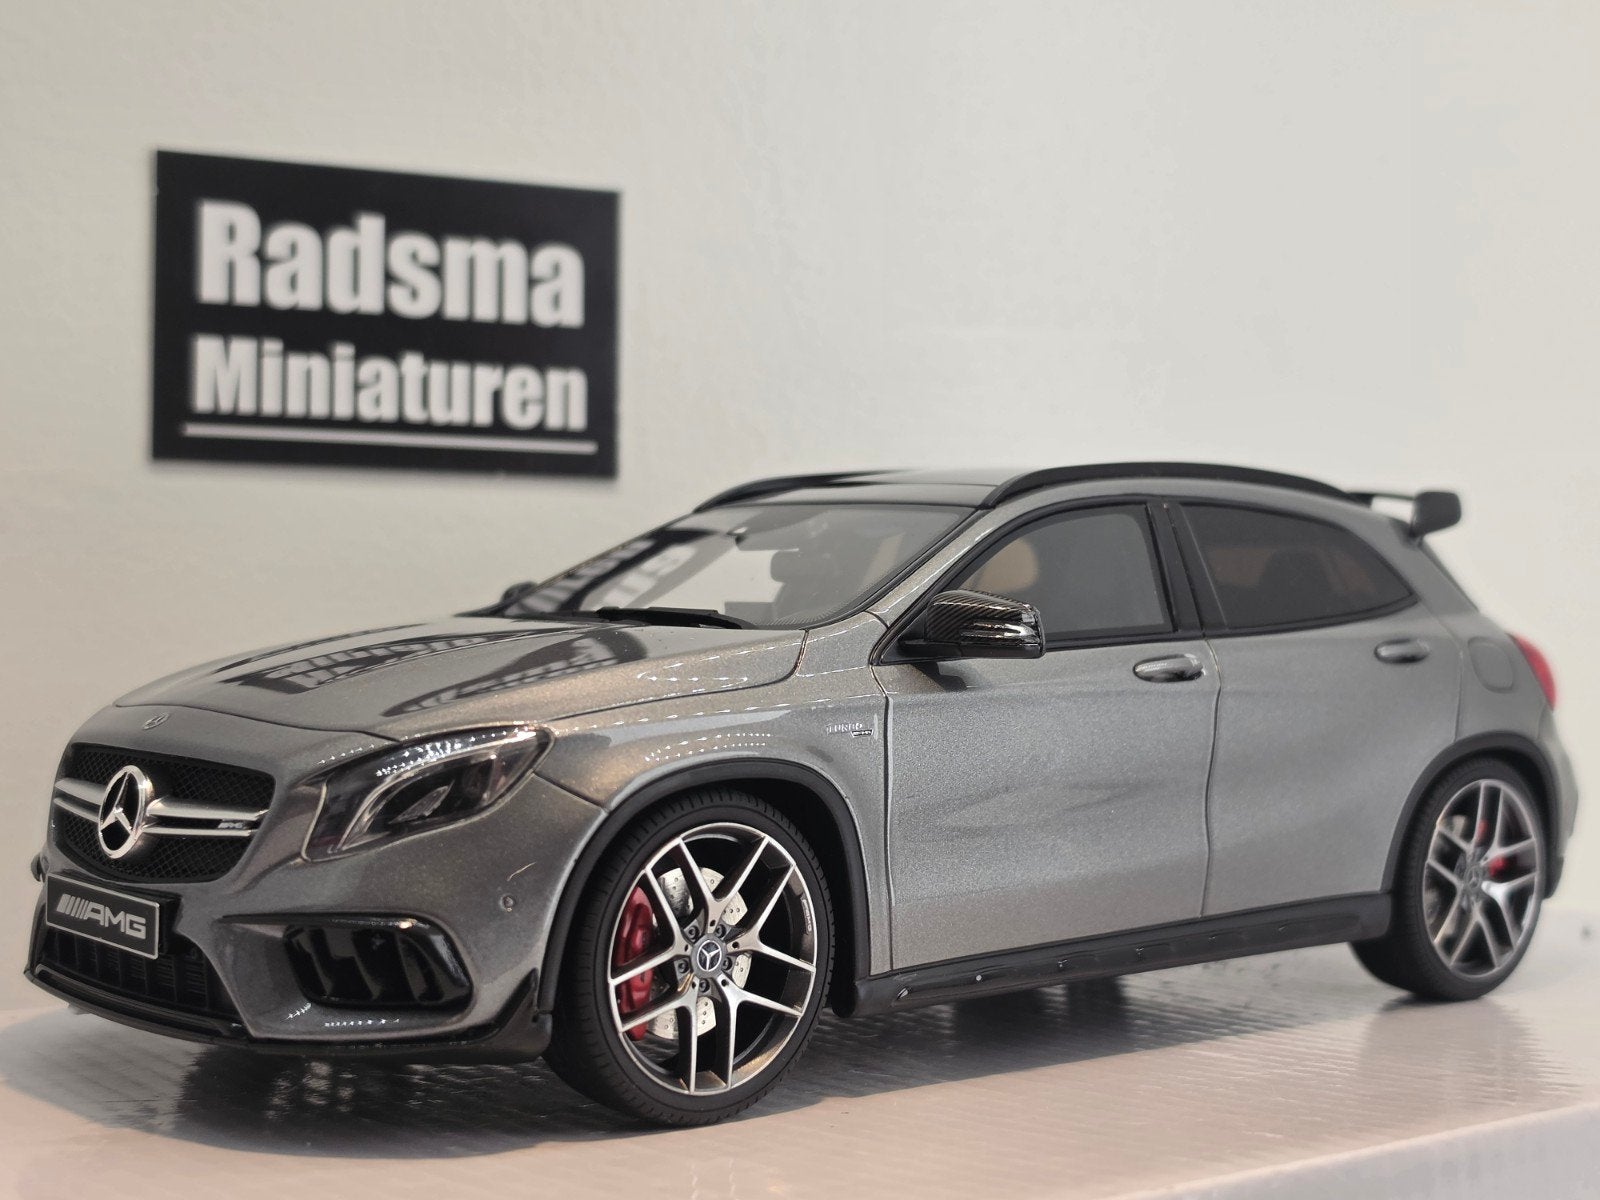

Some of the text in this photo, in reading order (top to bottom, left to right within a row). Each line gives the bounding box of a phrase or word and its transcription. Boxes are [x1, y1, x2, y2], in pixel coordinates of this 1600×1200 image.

[199, 200, 585, 328] Radsma
[193, 334, 588, 431] Miniaturen
[83, 901, 147, 939] AMG
